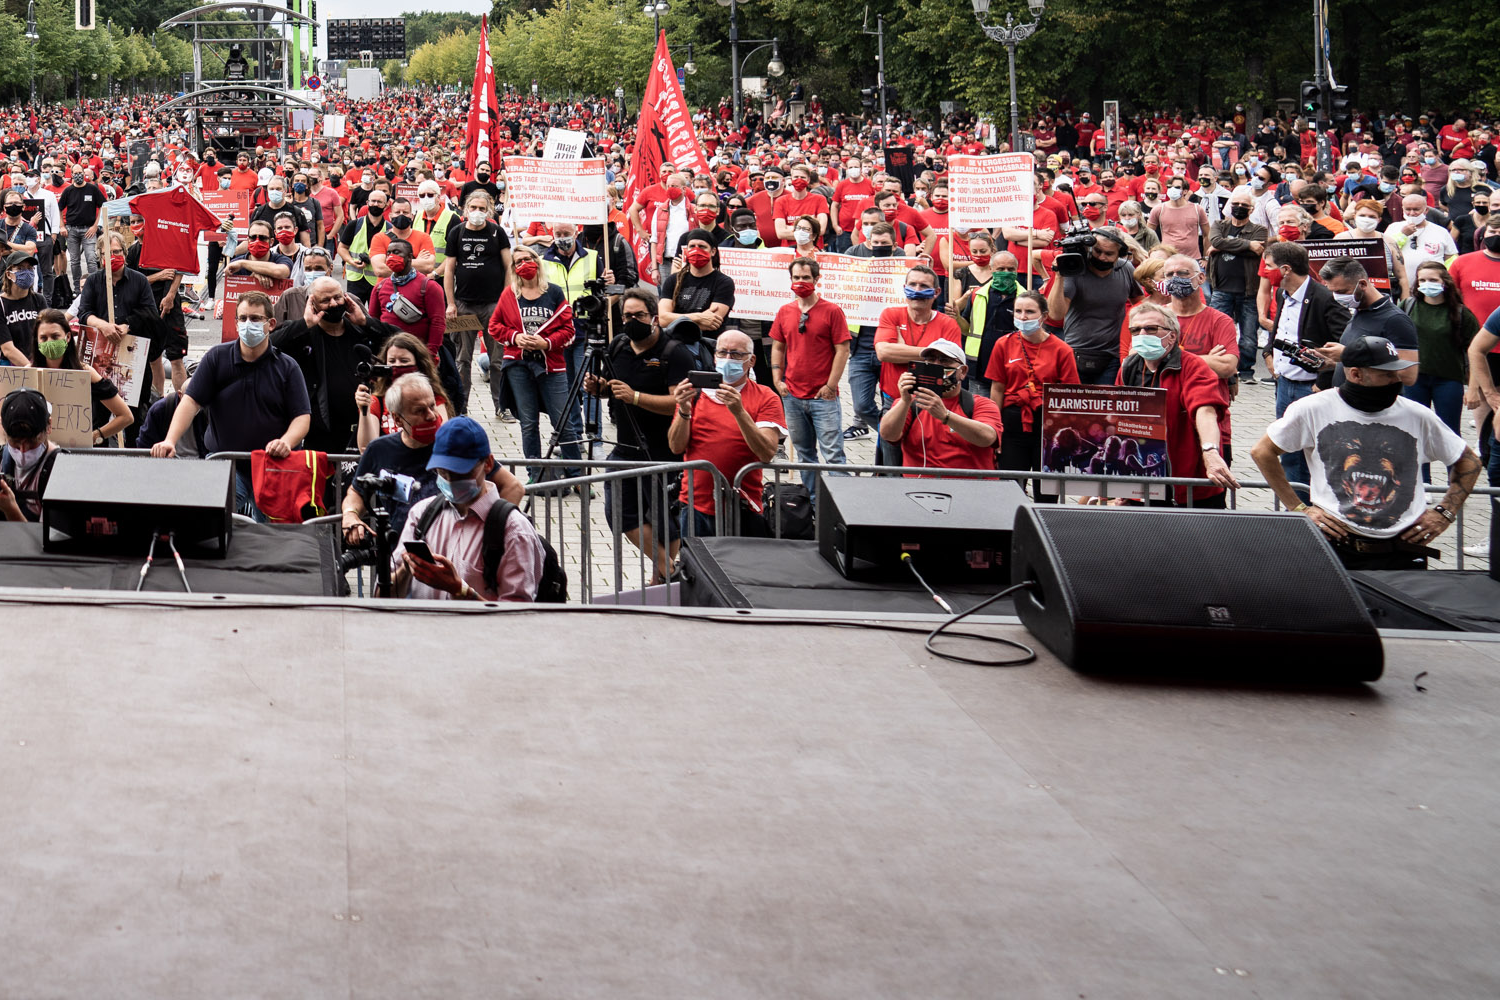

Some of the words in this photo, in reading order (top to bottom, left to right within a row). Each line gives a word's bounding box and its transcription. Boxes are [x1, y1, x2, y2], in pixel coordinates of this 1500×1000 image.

[556, 142, 578, 154] mag
[537, 160, 584, 168] VERGESSENE
[977, 156, 1022, 166] VERGESSENE
[506, 166, 605, 174] VERANSTALTUNGSBRANCHE
[981, 176, 1016, 184] STILLSTAND
[528, 185, 576, 194] UMSATZAUSFALL
[972, 185, 1022, 194] UMSATZAUSFALL
[720, 250, 772, 260] VERGESSENE
[1308, 248, 1347, 258] ARMSTUFE
[1349, 248, 1367, 256] ROT!
[852, 258, 906, 266] VERGESSENE
[722, 268, 758, 277] STILLSTAND
[734, 279, 761, 287] AUSFALL
[856, 276, 893, 284] STILLSTAND
[750, 289, 792, 298] FEHLANZEIGE
[843, 284, 896, 294] UMSATZAUSFALL
[824, 292, 884, 302] HILFSPROGRAMME
[6, 309, 38, 324] adidas
[84, 340, 94, 354] ROT!
[48, 371, 76, 388] THE
[1048, 398, 1113, 411] ALARMSTUFE
[1116, 400, 1139, 412] ROT!
[50, 402, 92, 433] ERTS
[1118, 421, 1148, 430] Diskotheken
